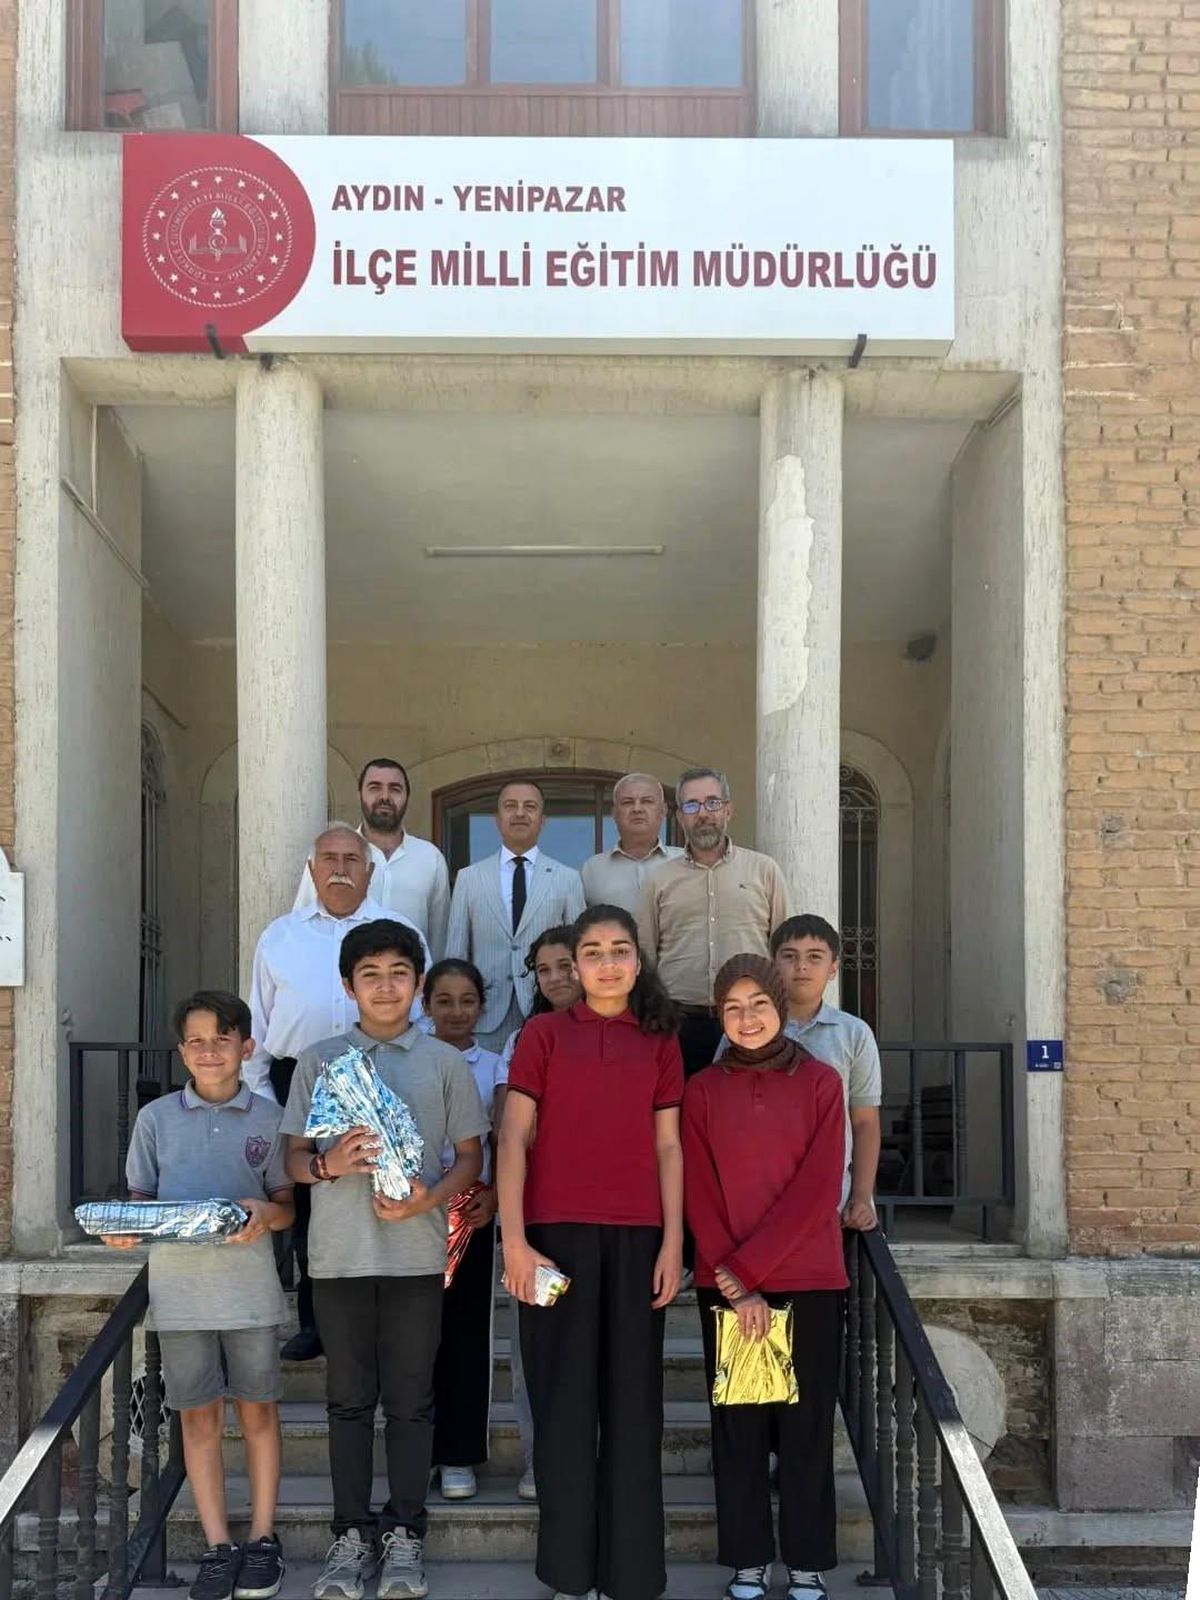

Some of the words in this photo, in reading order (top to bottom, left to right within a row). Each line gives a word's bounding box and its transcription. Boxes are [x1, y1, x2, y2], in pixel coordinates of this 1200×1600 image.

[331, 184, 424, 212] AYDIN
[453, 180, 627, 213] YENİPAZAR
[333, 240, 417, 295] İLÇE
[431, 240, 531, 286] MİLLİ
[546, 241, 679, 287] EĞİTİM
[693, 243, 937, 289] MÜDÜRLÜĞÜ
[1041, 1045, 1050, 1059] 1
